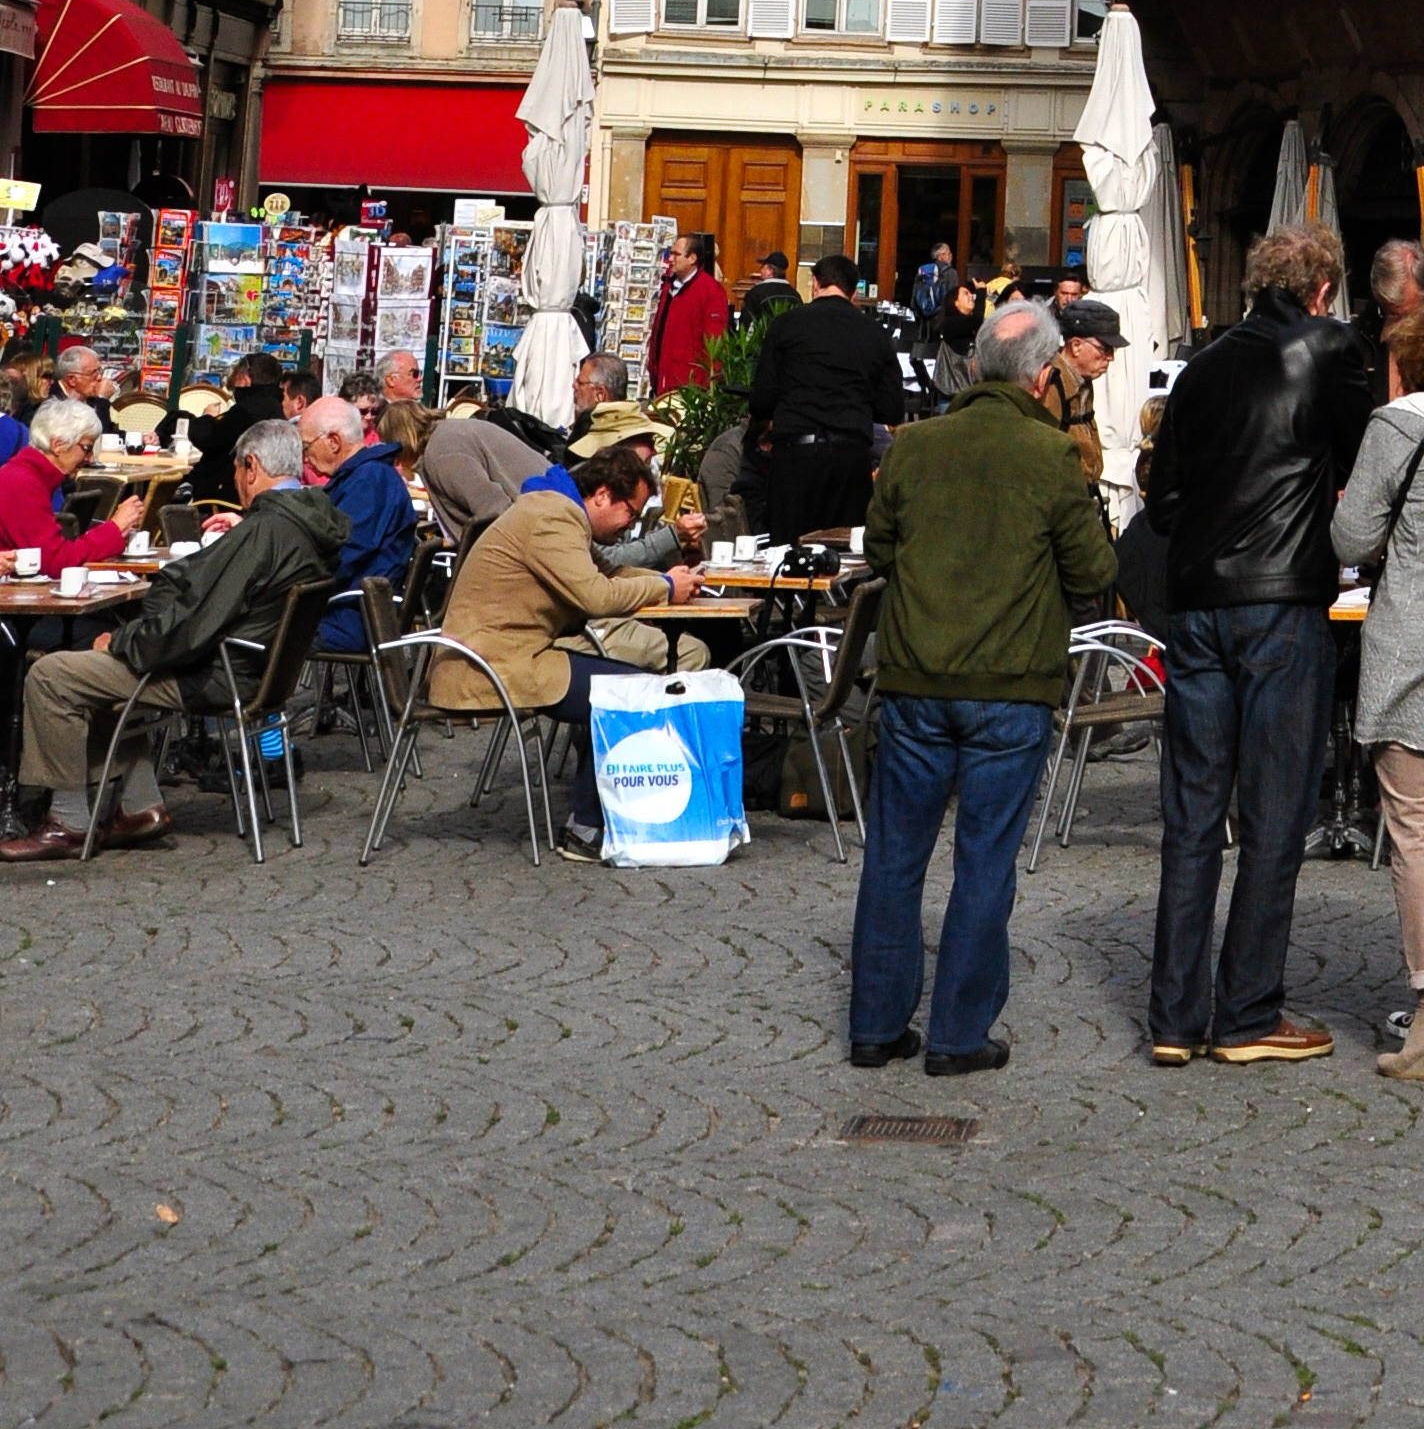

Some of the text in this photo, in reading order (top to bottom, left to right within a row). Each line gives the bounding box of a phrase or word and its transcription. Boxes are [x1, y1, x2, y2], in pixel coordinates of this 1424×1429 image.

[864, 99, 996, 115] PARASHOP
[622, 763, 655, 774] FAIRE
[657, 763, 686, 773] PLUS
[614, 774, 679, 789] POUR VOUS
